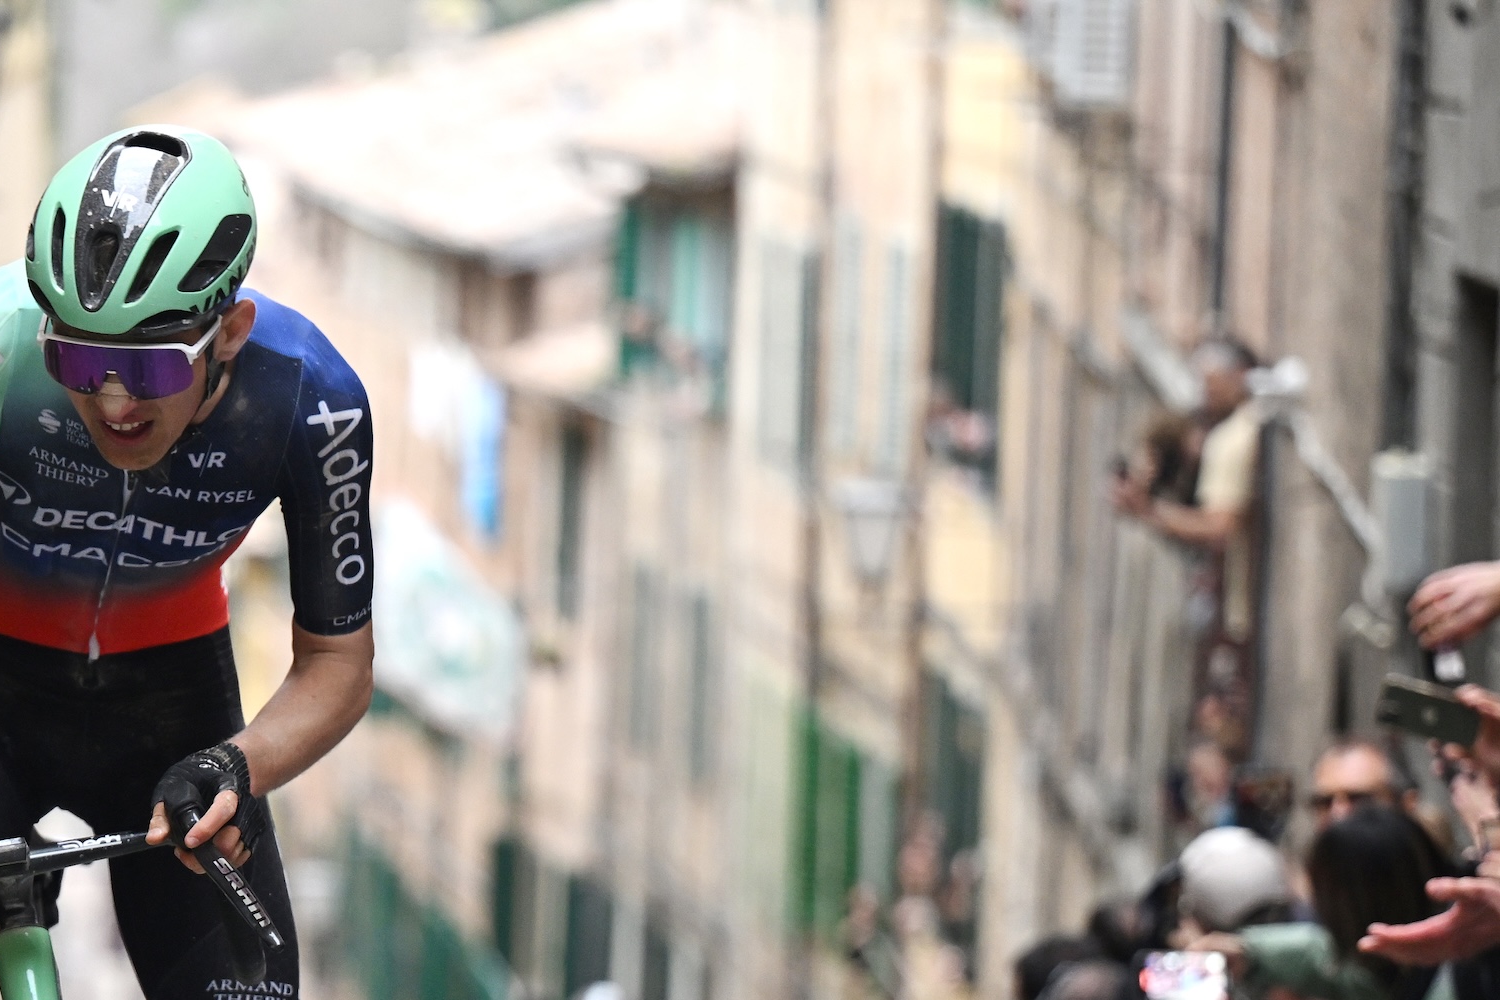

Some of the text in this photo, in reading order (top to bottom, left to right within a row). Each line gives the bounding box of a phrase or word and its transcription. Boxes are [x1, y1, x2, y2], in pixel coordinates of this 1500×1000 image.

[66, 418, 84, 431] UCI
[29, 446, 109, 478] ARMAND
[35, 462, 99, 487] THIERY
[197, 490, 255, 503] RYSEL
[306, 400, 369, 585] Adecco
[33, 507, 248, 547] DECATHLO
[213, 857, 271, 928] SRAM
[206, 978, 294, 996] ARMAND
